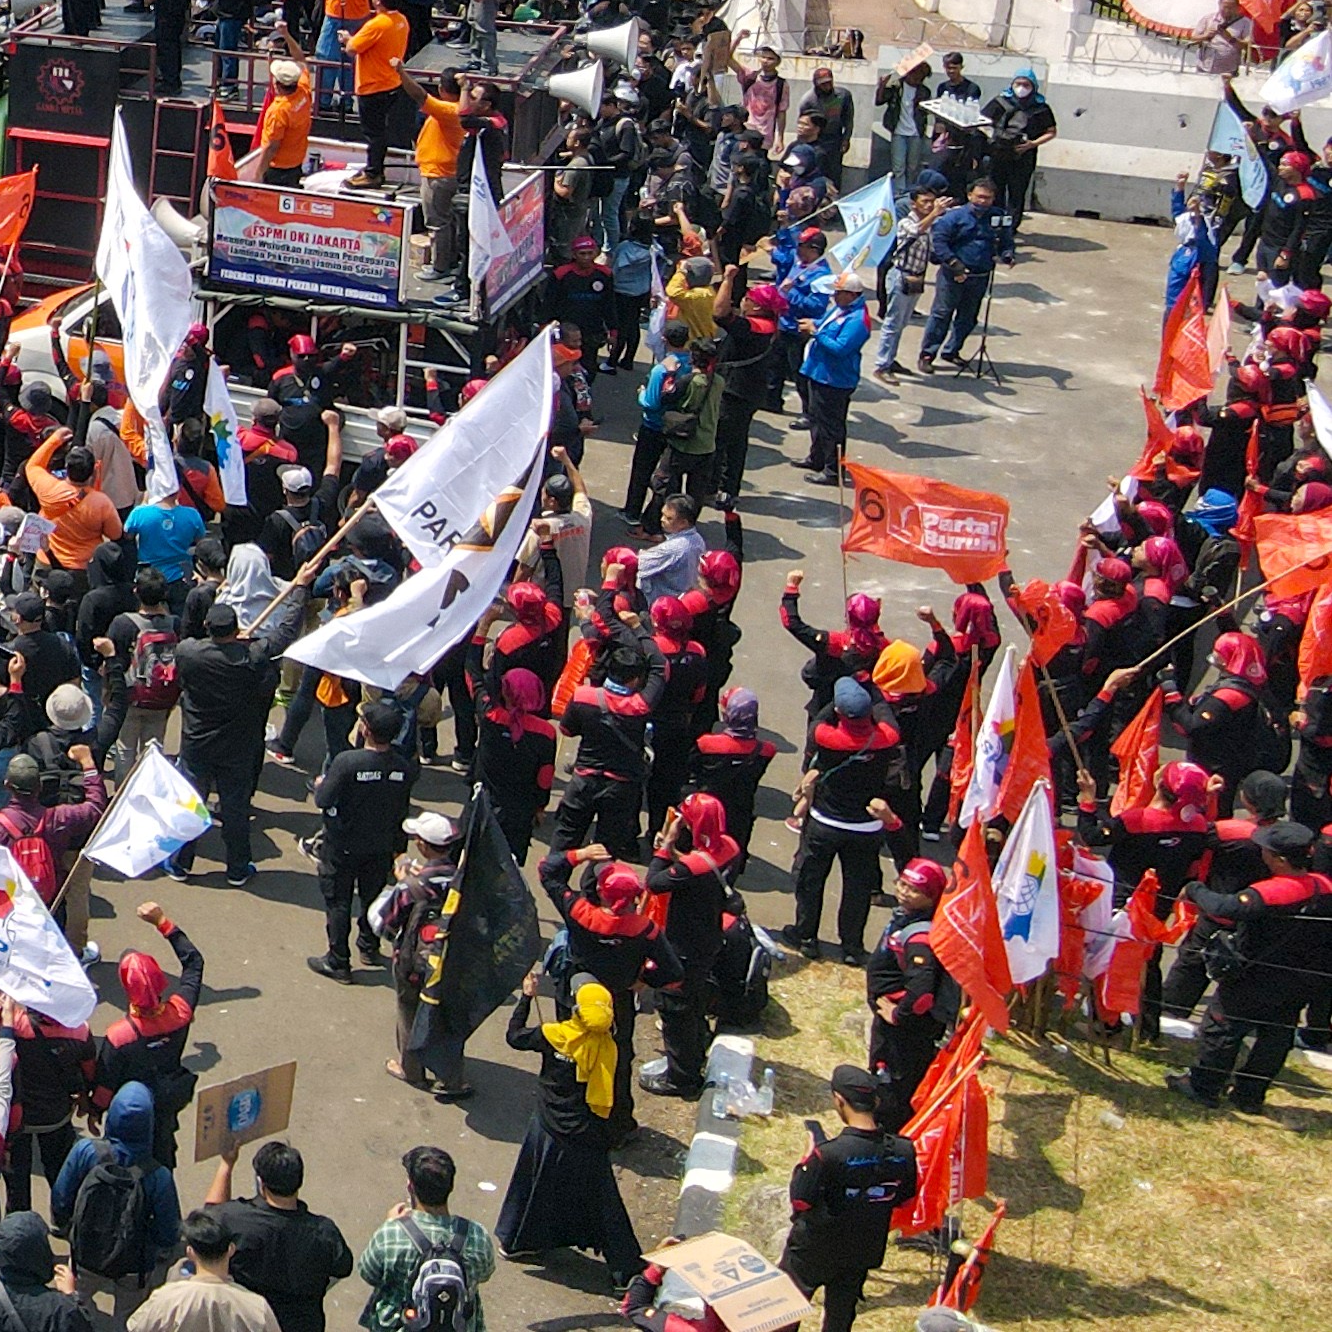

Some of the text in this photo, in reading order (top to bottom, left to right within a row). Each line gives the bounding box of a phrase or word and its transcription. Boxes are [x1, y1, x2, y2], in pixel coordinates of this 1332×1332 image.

[209, 124, 225, 151] 6
[282, 198, 291, 210] 6
[252, 223, 286, 241] FSPMI
[311, 232, 361, 251] JAKARTA
[355, 265, 384, 278] Sosial
[860, 487, 885, 522] 6
[922, 512, 998, 536] Partai
[923, 530, 997, 552] Buruh
